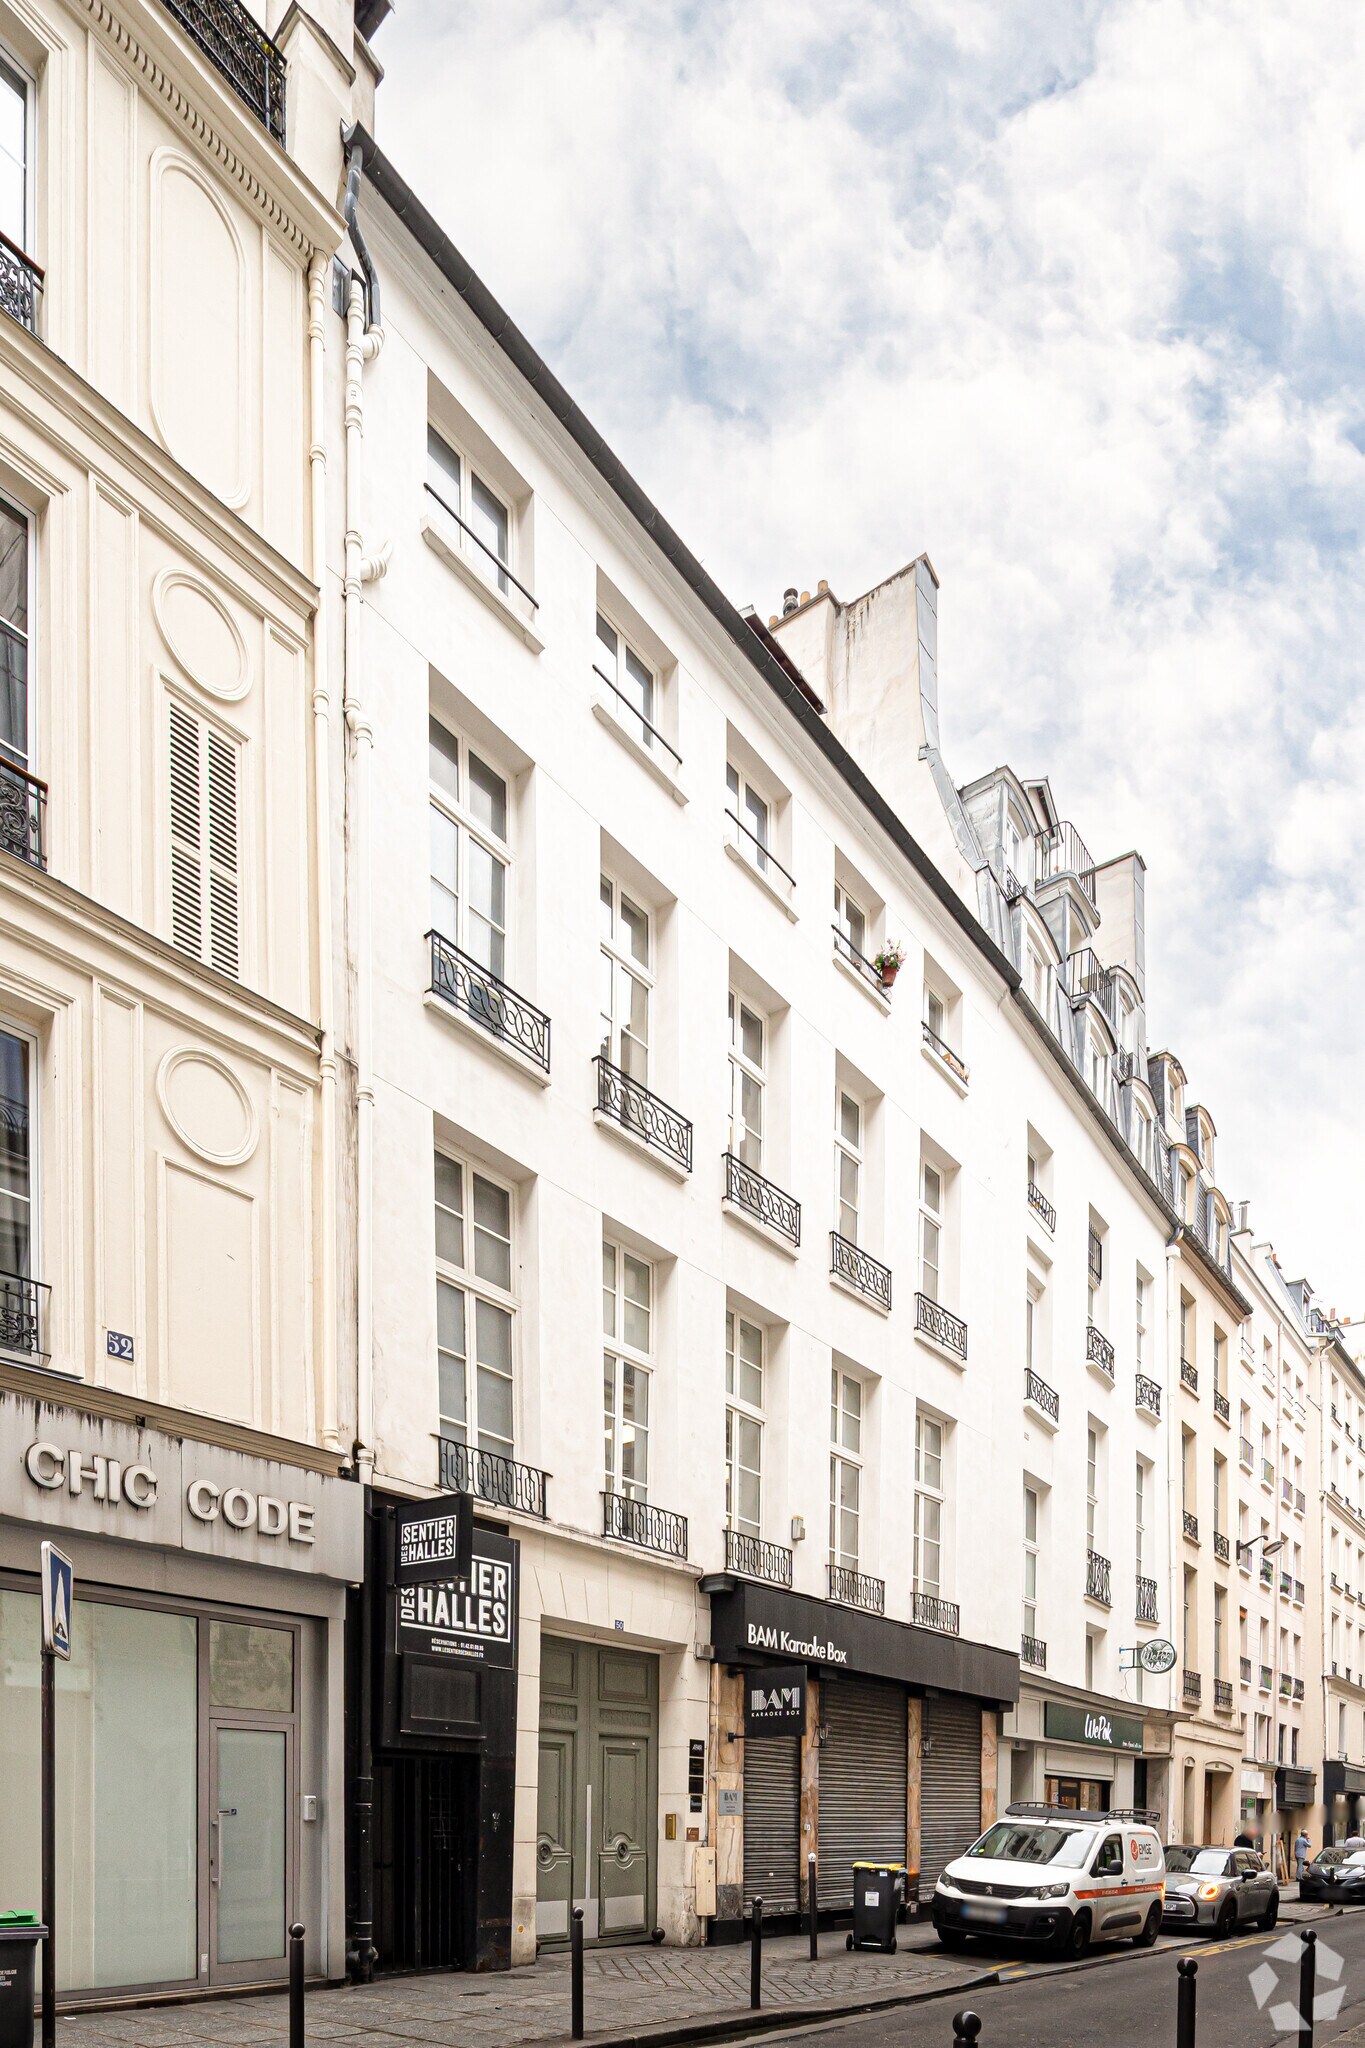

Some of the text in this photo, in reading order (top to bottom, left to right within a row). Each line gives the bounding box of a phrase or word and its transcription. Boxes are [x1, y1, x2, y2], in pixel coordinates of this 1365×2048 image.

[107, 1333, 133, 1359] 52
[25, 1442, 316, 1544] CHIC CODE
[403, 1519, 454, 1544] SENTIER
[408, 1538, 453, 1562] HALLES
[401, 1588, 415, 1620] DES
[418, 1587, 507, 1636] HALLES
[616, 1621, 624, 1630] 50
[747, 1623, 847, 1664] BAM Karaoke Box
[751, 1687, 800, 1710] BAM
[751, 1710, 782, 1718] KARAOKE
[1084, 1713, 1113, 1744] WePok
